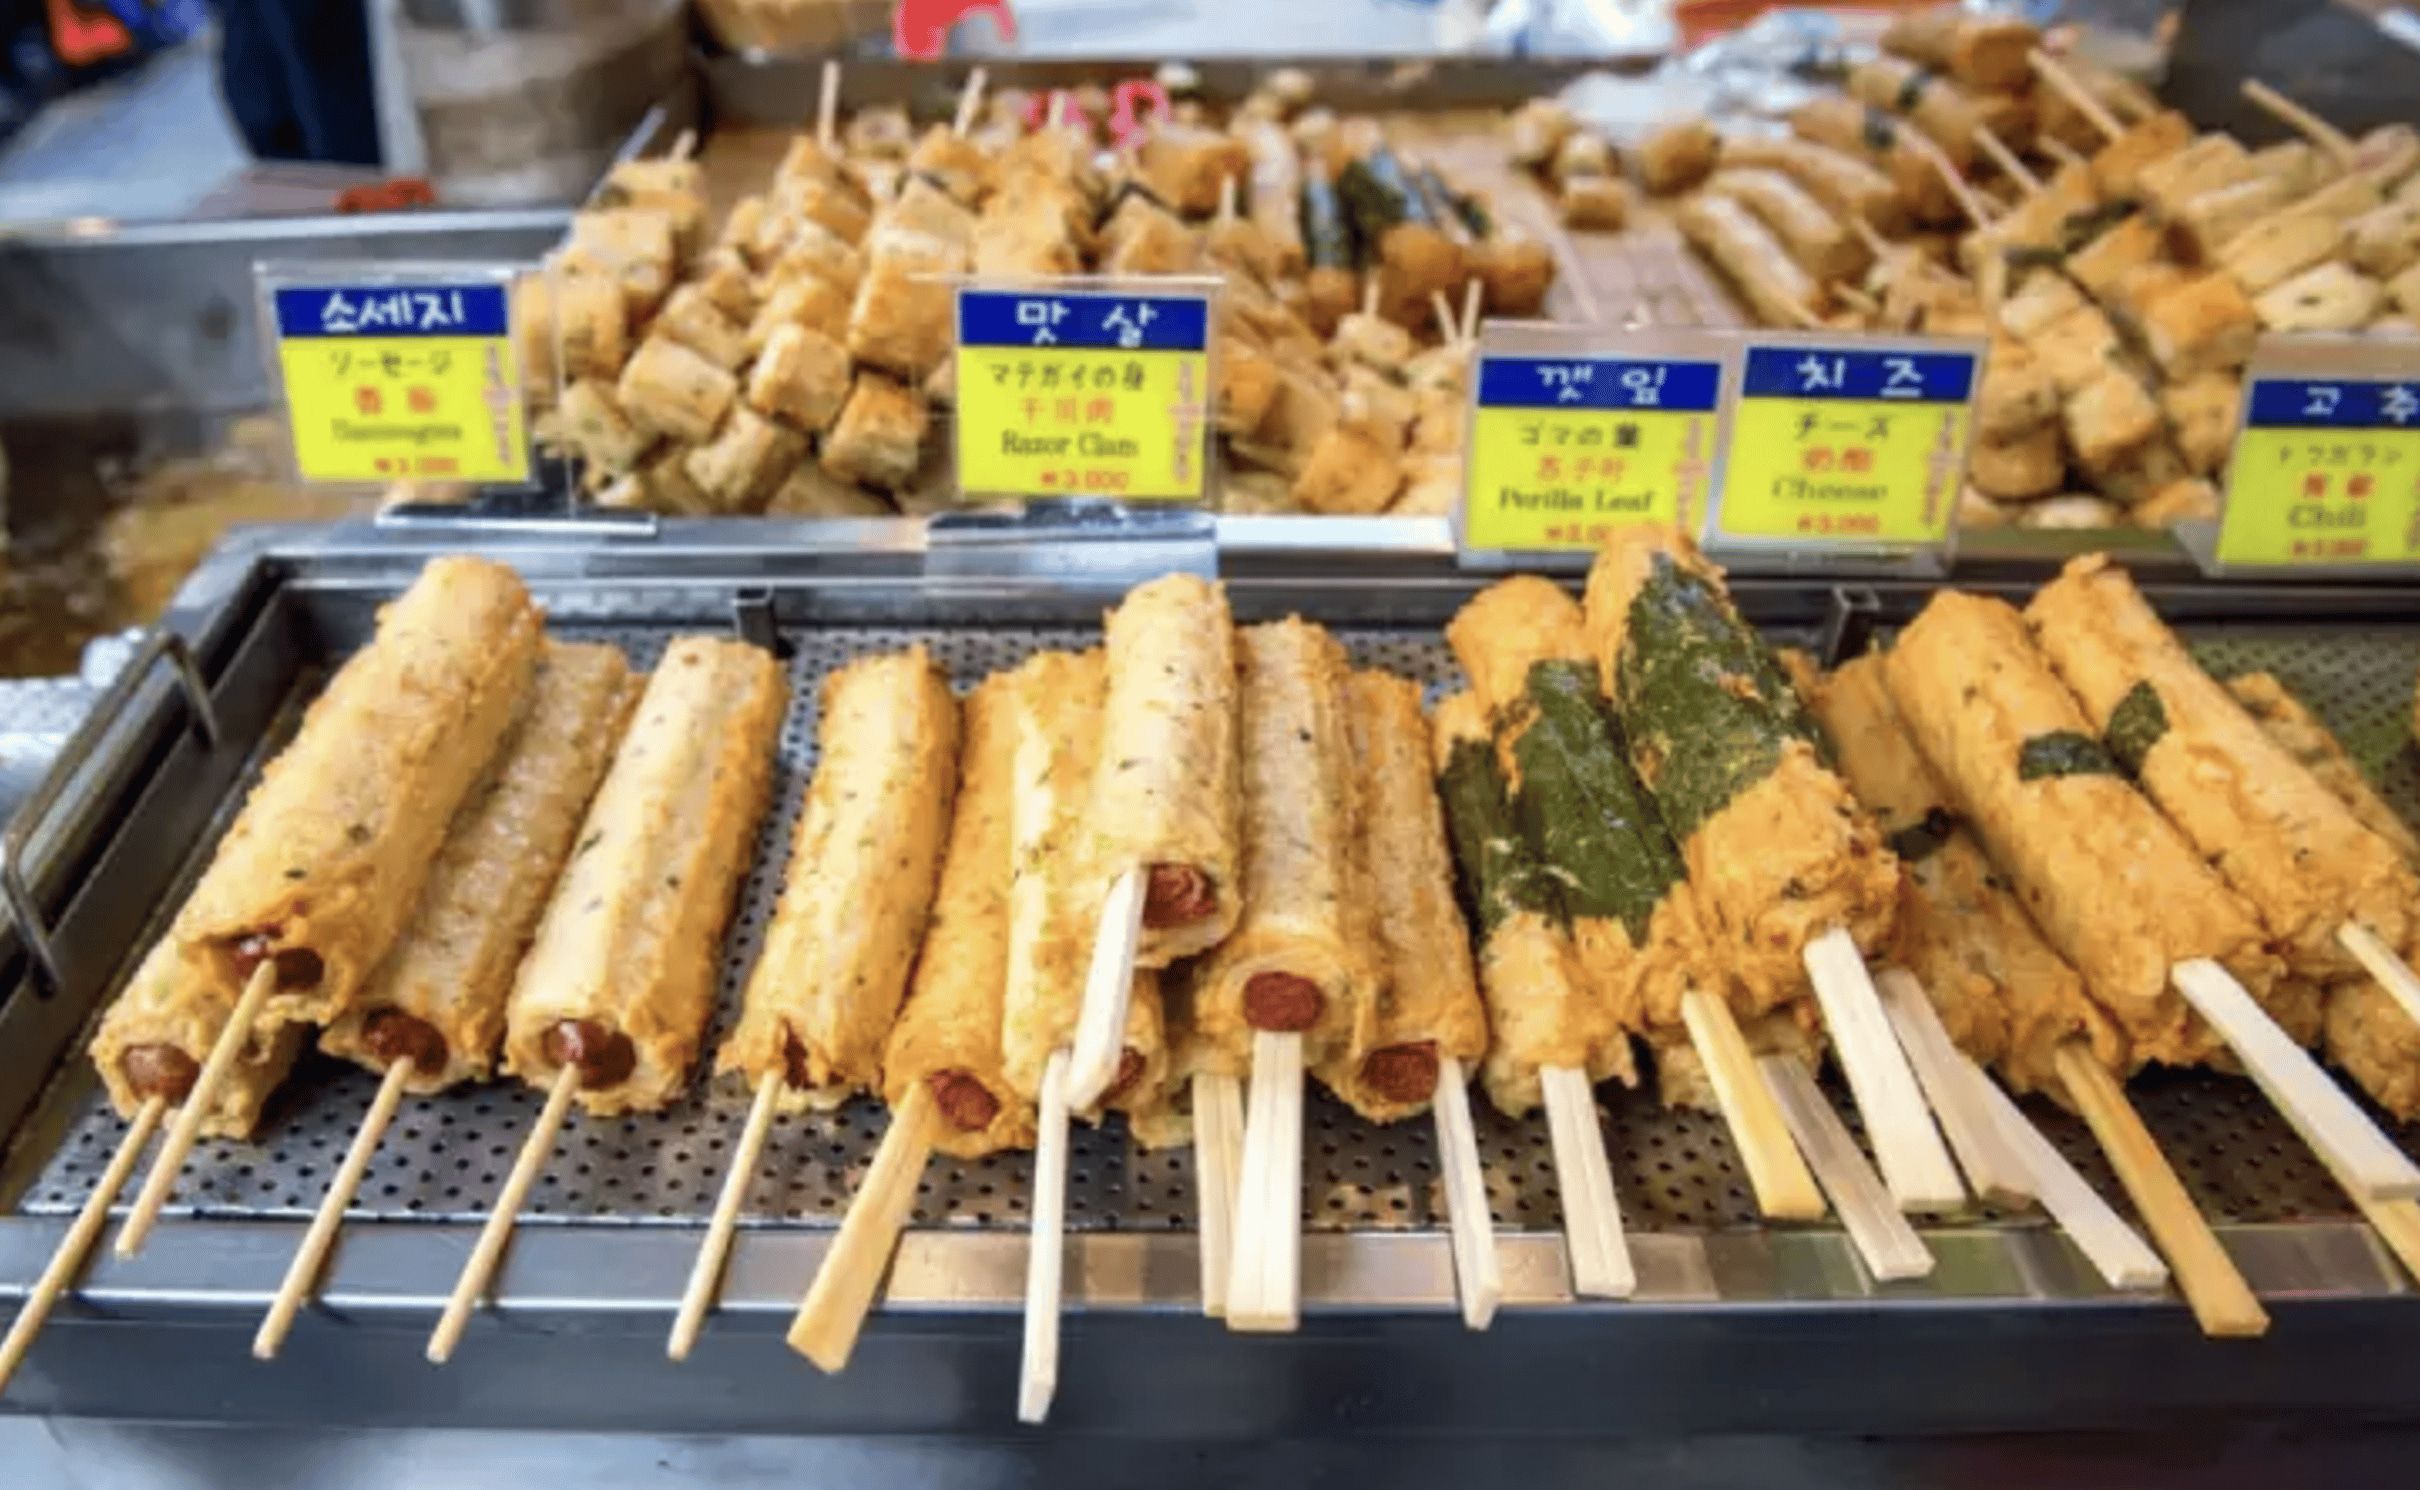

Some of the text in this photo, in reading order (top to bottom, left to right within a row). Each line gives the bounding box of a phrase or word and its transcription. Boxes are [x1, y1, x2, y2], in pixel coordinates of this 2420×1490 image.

[320, 291, 466, 332] 소세지
[1000, 429, 1140, 457] Razor Clam
